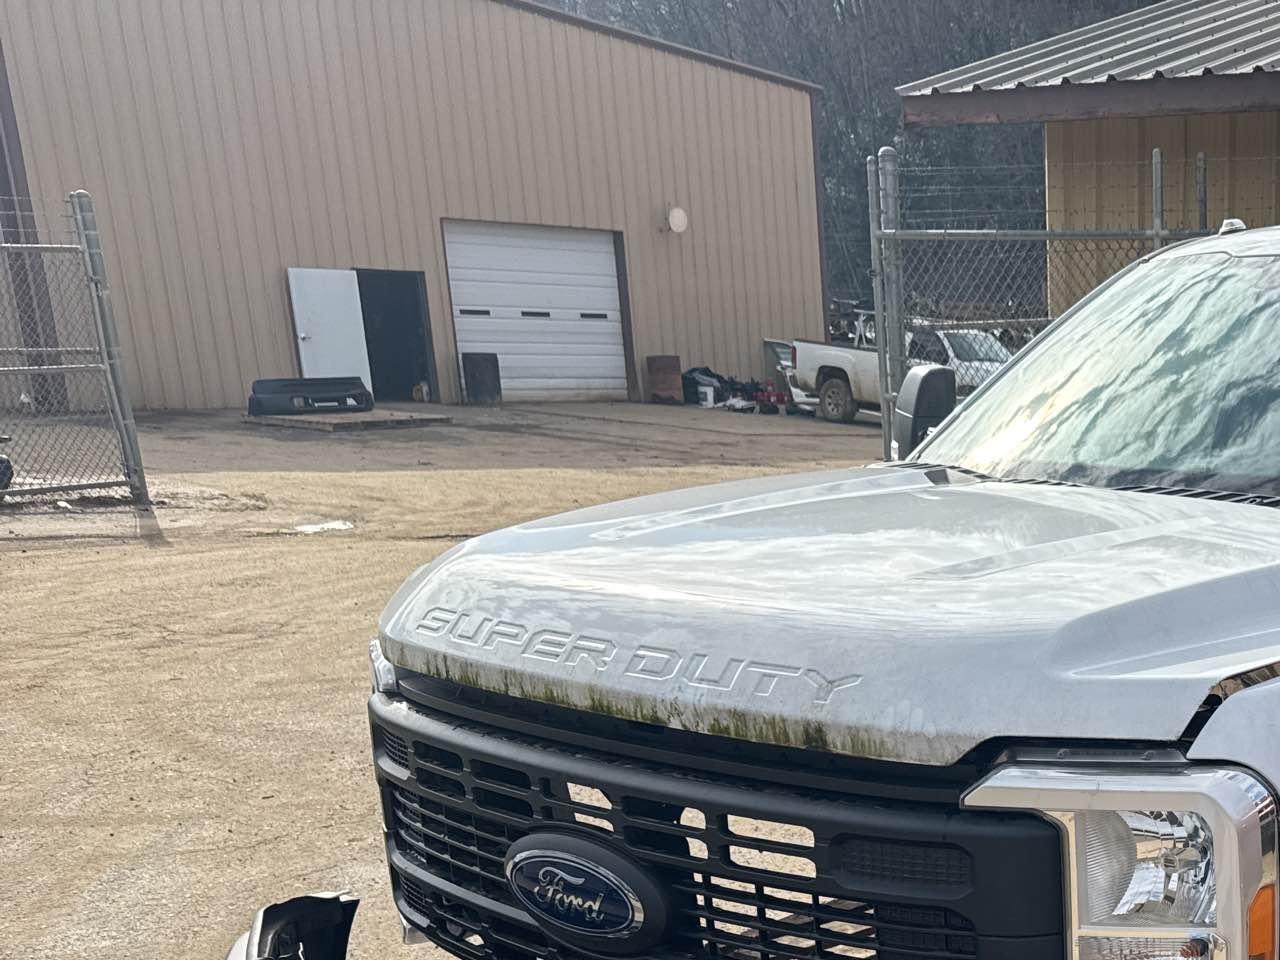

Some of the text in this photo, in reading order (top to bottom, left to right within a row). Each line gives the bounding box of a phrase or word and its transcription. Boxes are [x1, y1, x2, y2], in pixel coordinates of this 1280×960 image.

[416, 606, 863, 704] SUPER DUTY
[533, 866, 605, 921] Ford
